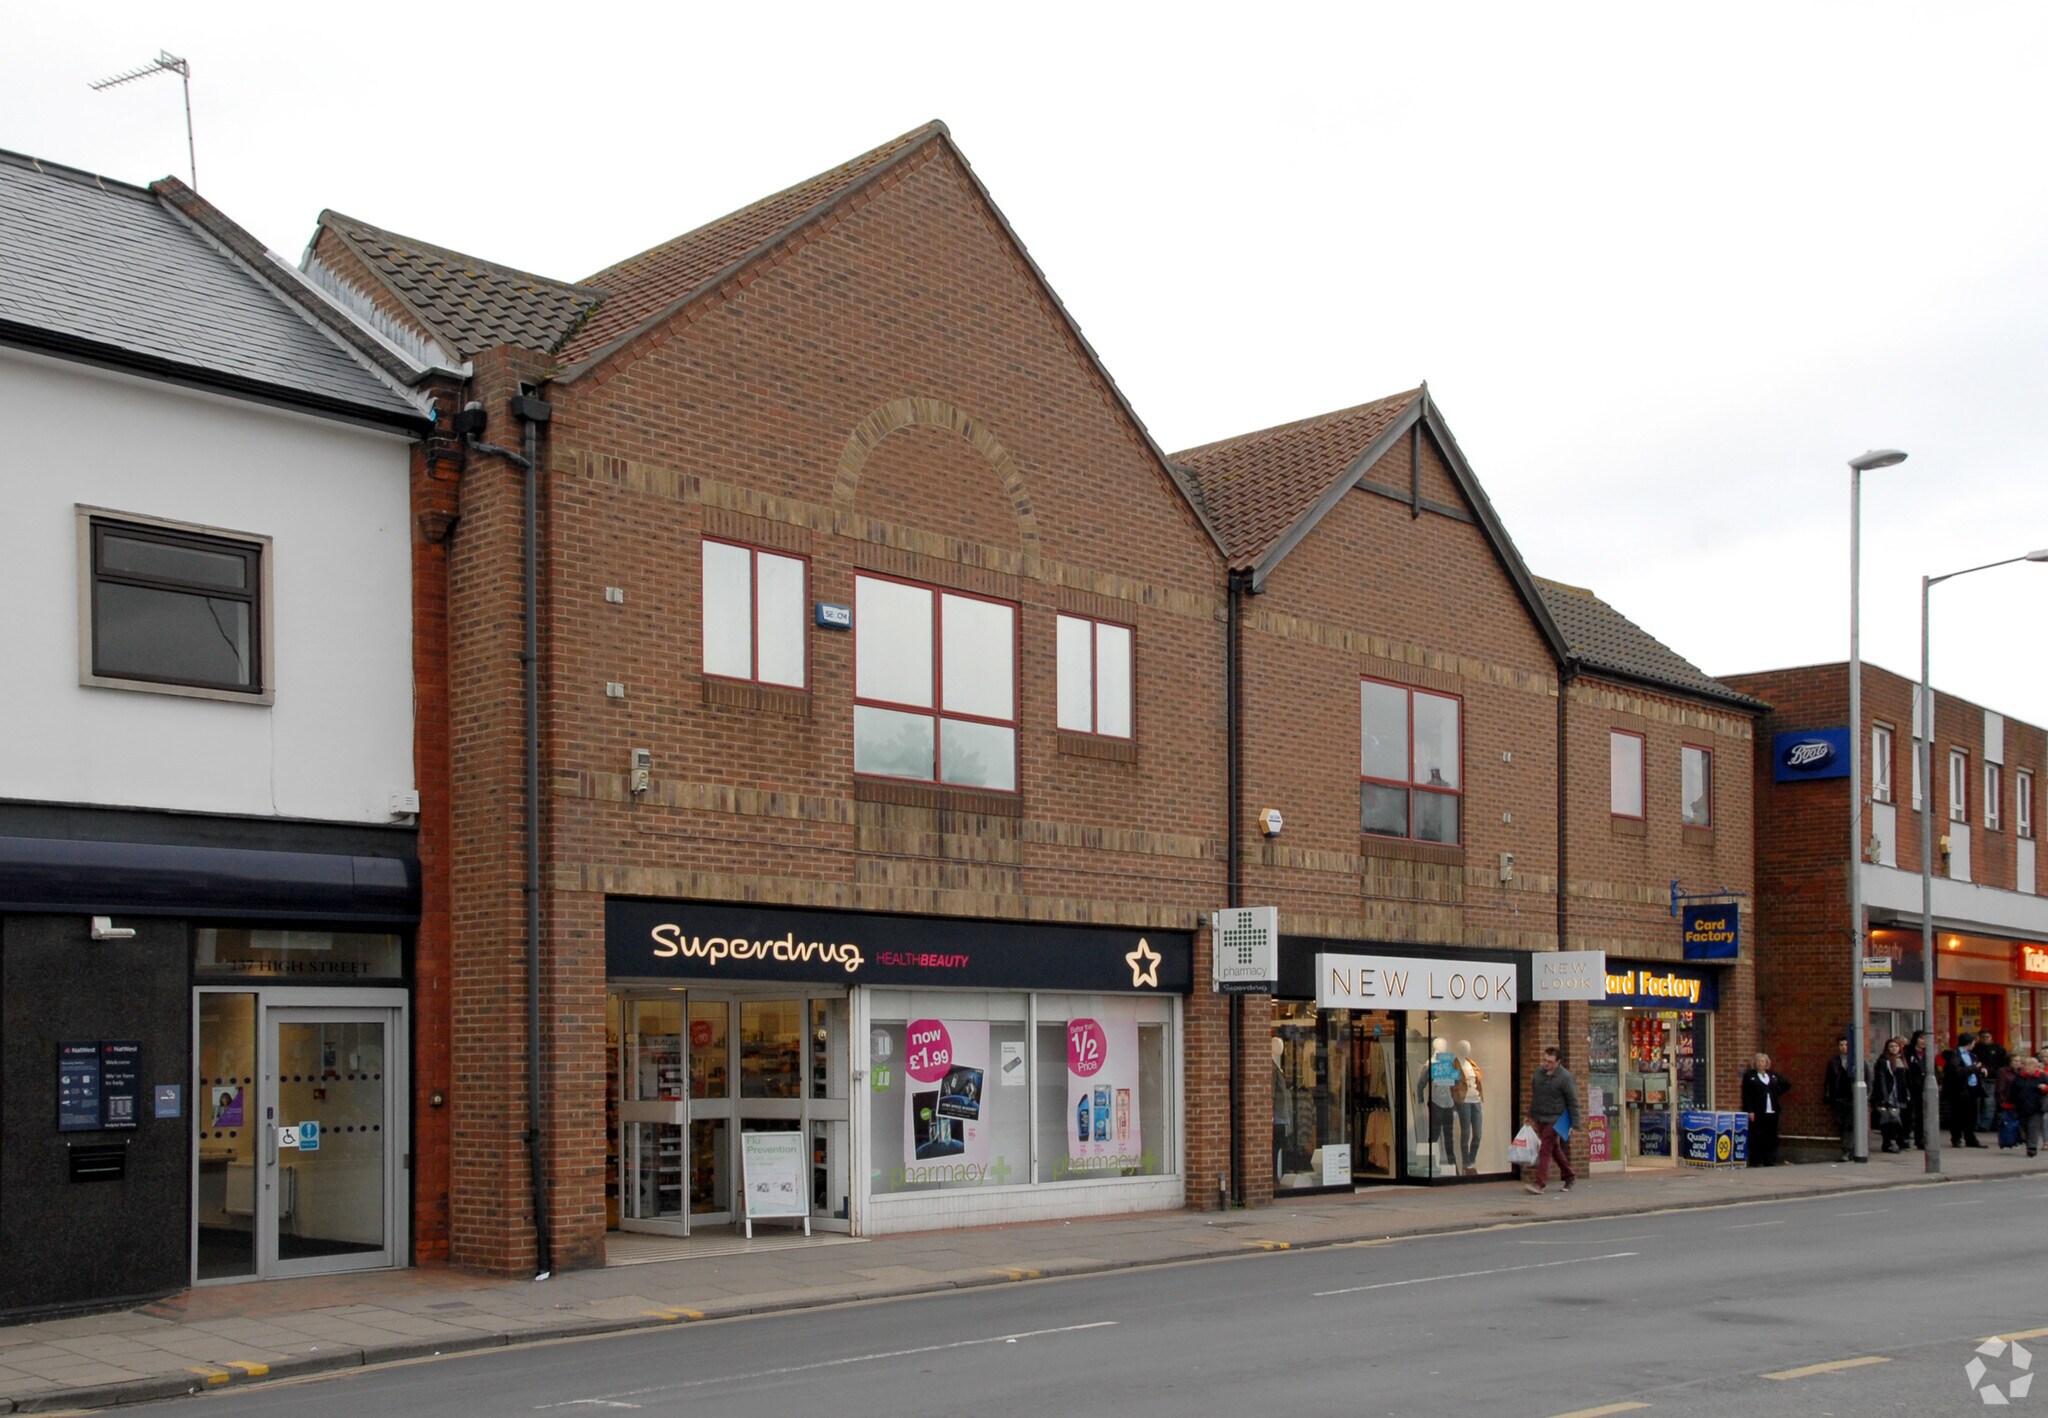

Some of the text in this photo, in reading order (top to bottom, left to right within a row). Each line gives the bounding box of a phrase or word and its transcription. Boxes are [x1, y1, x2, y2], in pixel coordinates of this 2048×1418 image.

[1787, 742, 1829, 765] Boots
[1695, 919, 1725, 931] Card
[1685, 931, 1735, 943] Factory
[651, 923, 864, 973] Superdrug
[258, 961, 303, 972] HIGH
[309, 961, 371, 973] STREET
[1224, 966, 1267, 978] pharmacy
[1544, 963, 1587, 974] NEW
[1330, 968, 1512, 1001] NEW LOOK
[1540, 977, 1592, 990] LOOK
[1605, 970, 1701, 1004] ard Factory
[912, 1029, 941, 1045] now
[909, 1047, 949, 1071] £1.99
[1078, 1060, 1097, 1072] Price
[748, 1136, 761, 1145] Flu
[1640, 1132, 1663, 1143] Quality
[1687, 1132, 1712, 1144] Quality
[747, 1146, 797, 1154] Prevention
[1693, 1142, 1707, 1150] and
[1719, 1141, 1730, 1154] 99
[1689, 1150, 1710, 1159] Value
[1051, 1152, 1139, 1181] pharmacy
[890, 1163, 988, 1192] pharmacy
